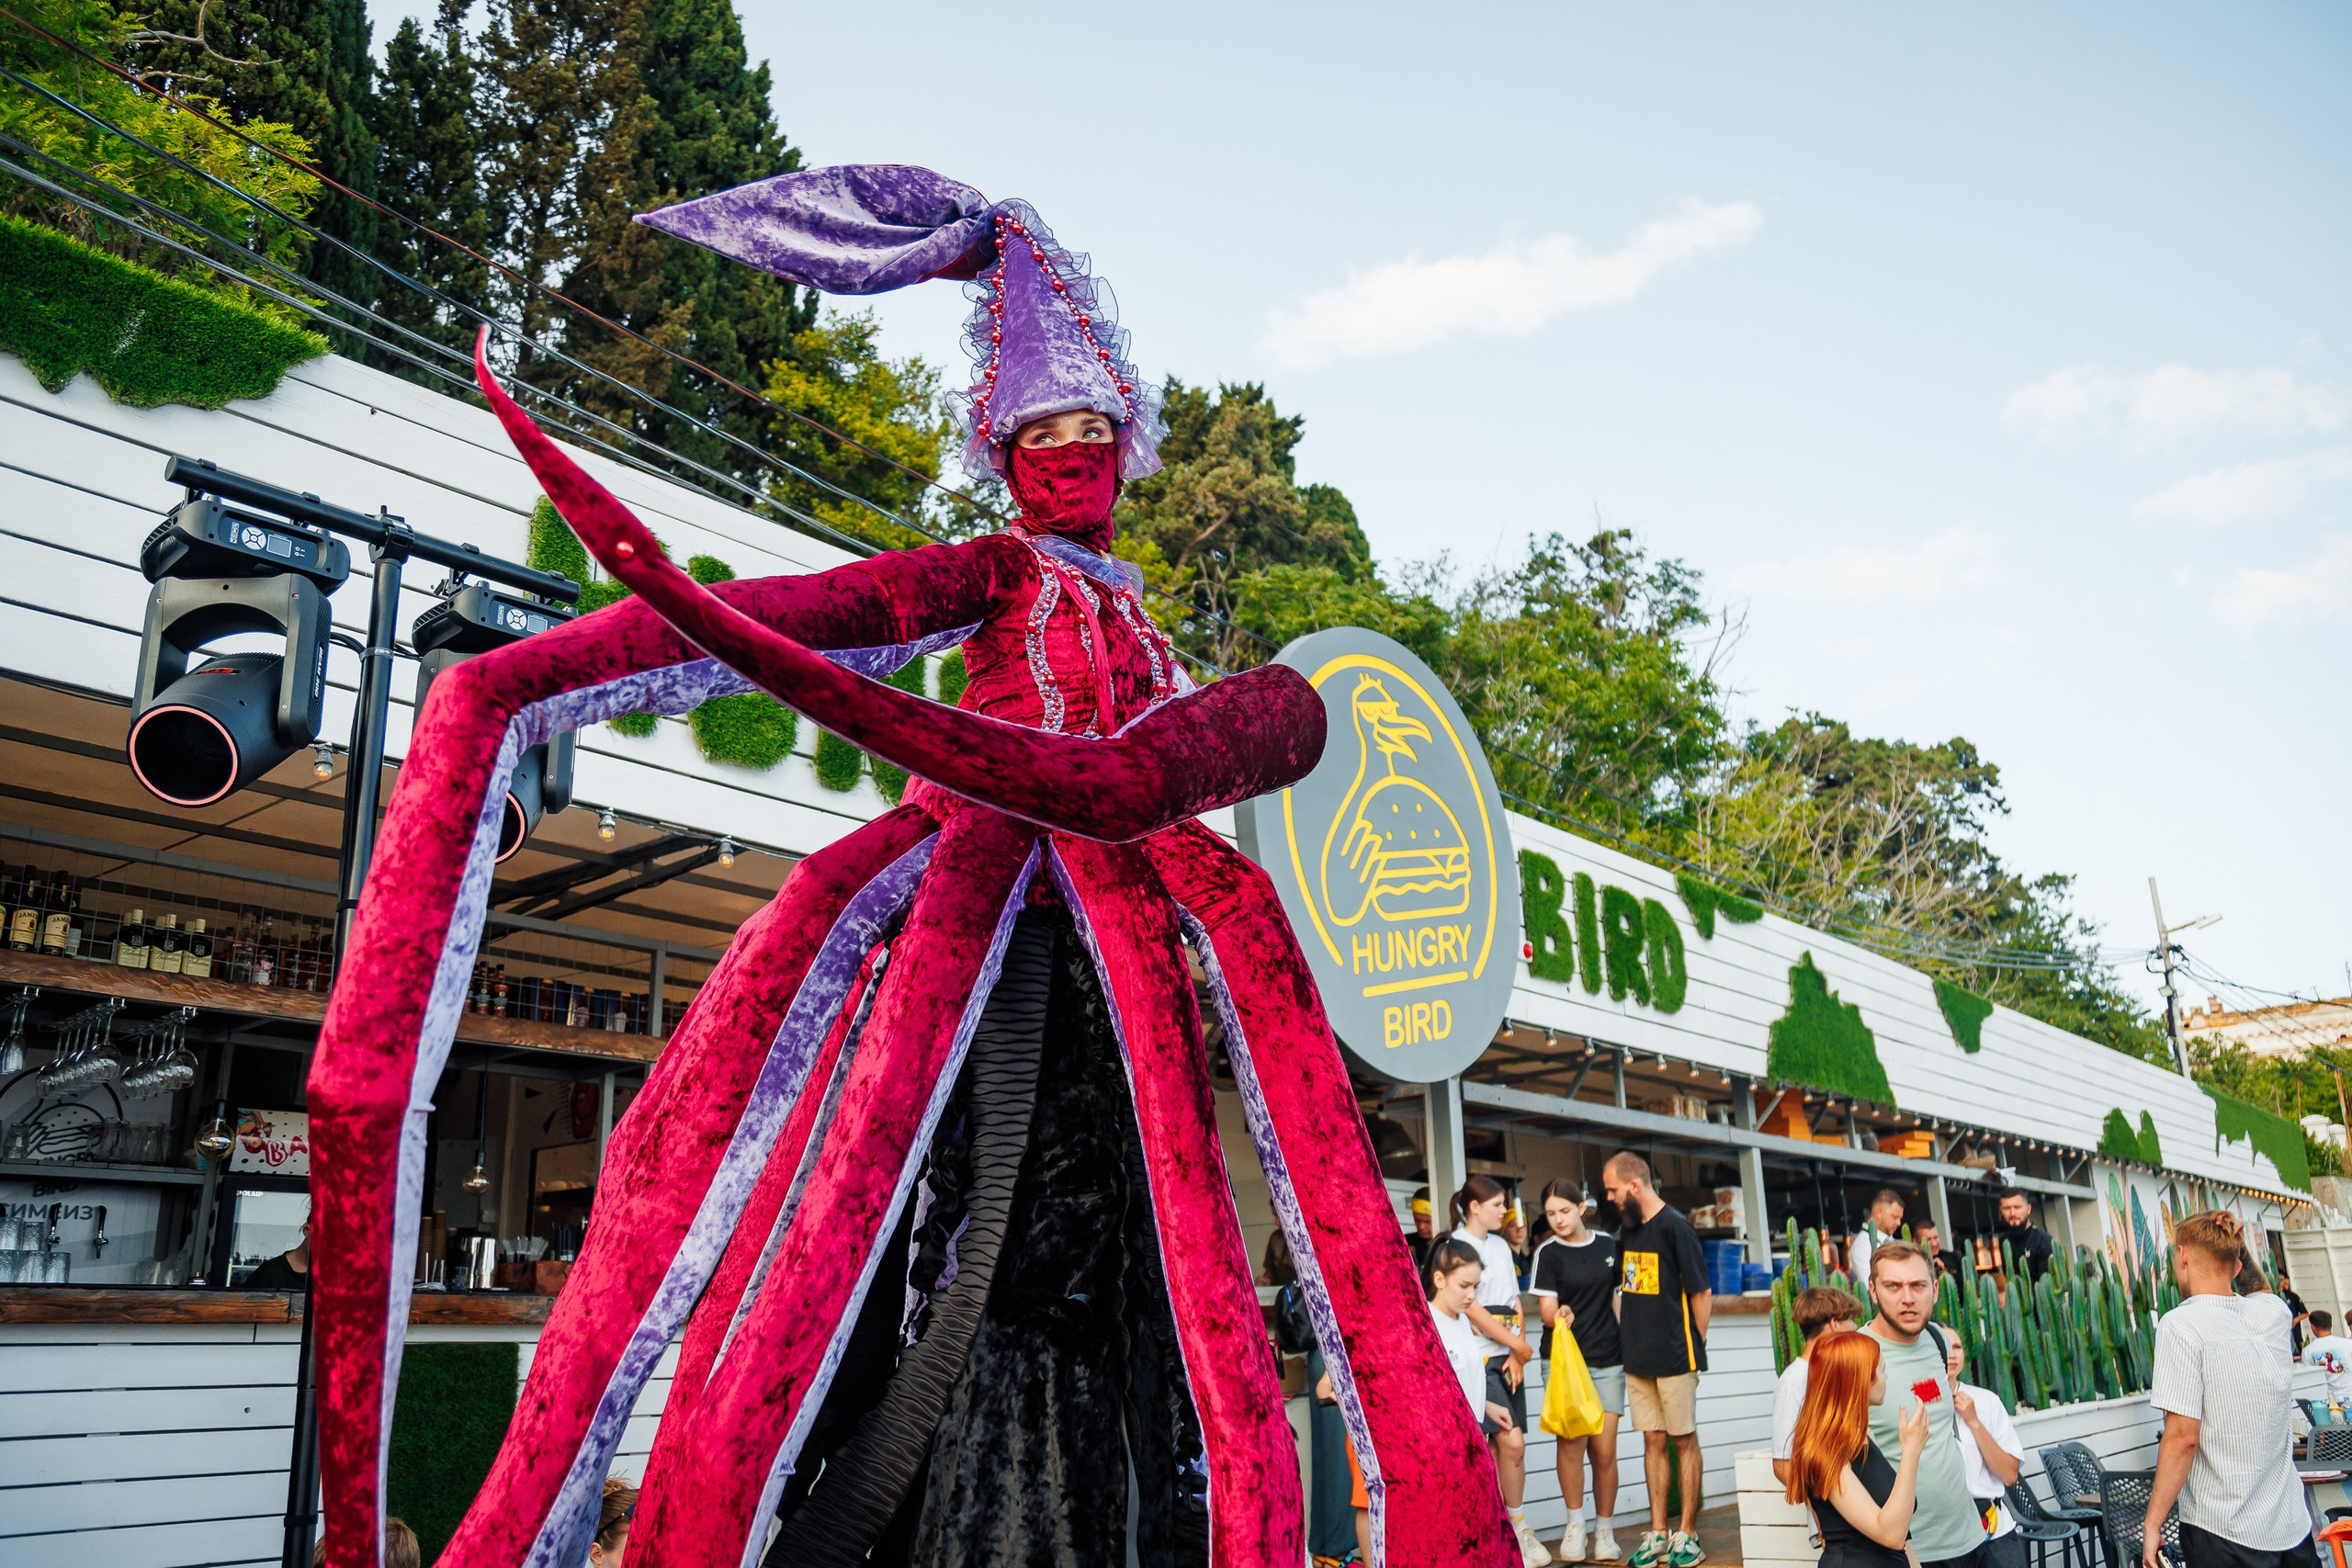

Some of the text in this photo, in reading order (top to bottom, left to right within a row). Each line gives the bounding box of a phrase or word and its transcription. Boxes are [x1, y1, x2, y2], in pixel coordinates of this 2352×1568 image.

[1352, 923, 1471, 975] HUNGRY
[1519, 849, 1687, 1014] BIRD
[1384, 999, 1453, 1048] BIRD
